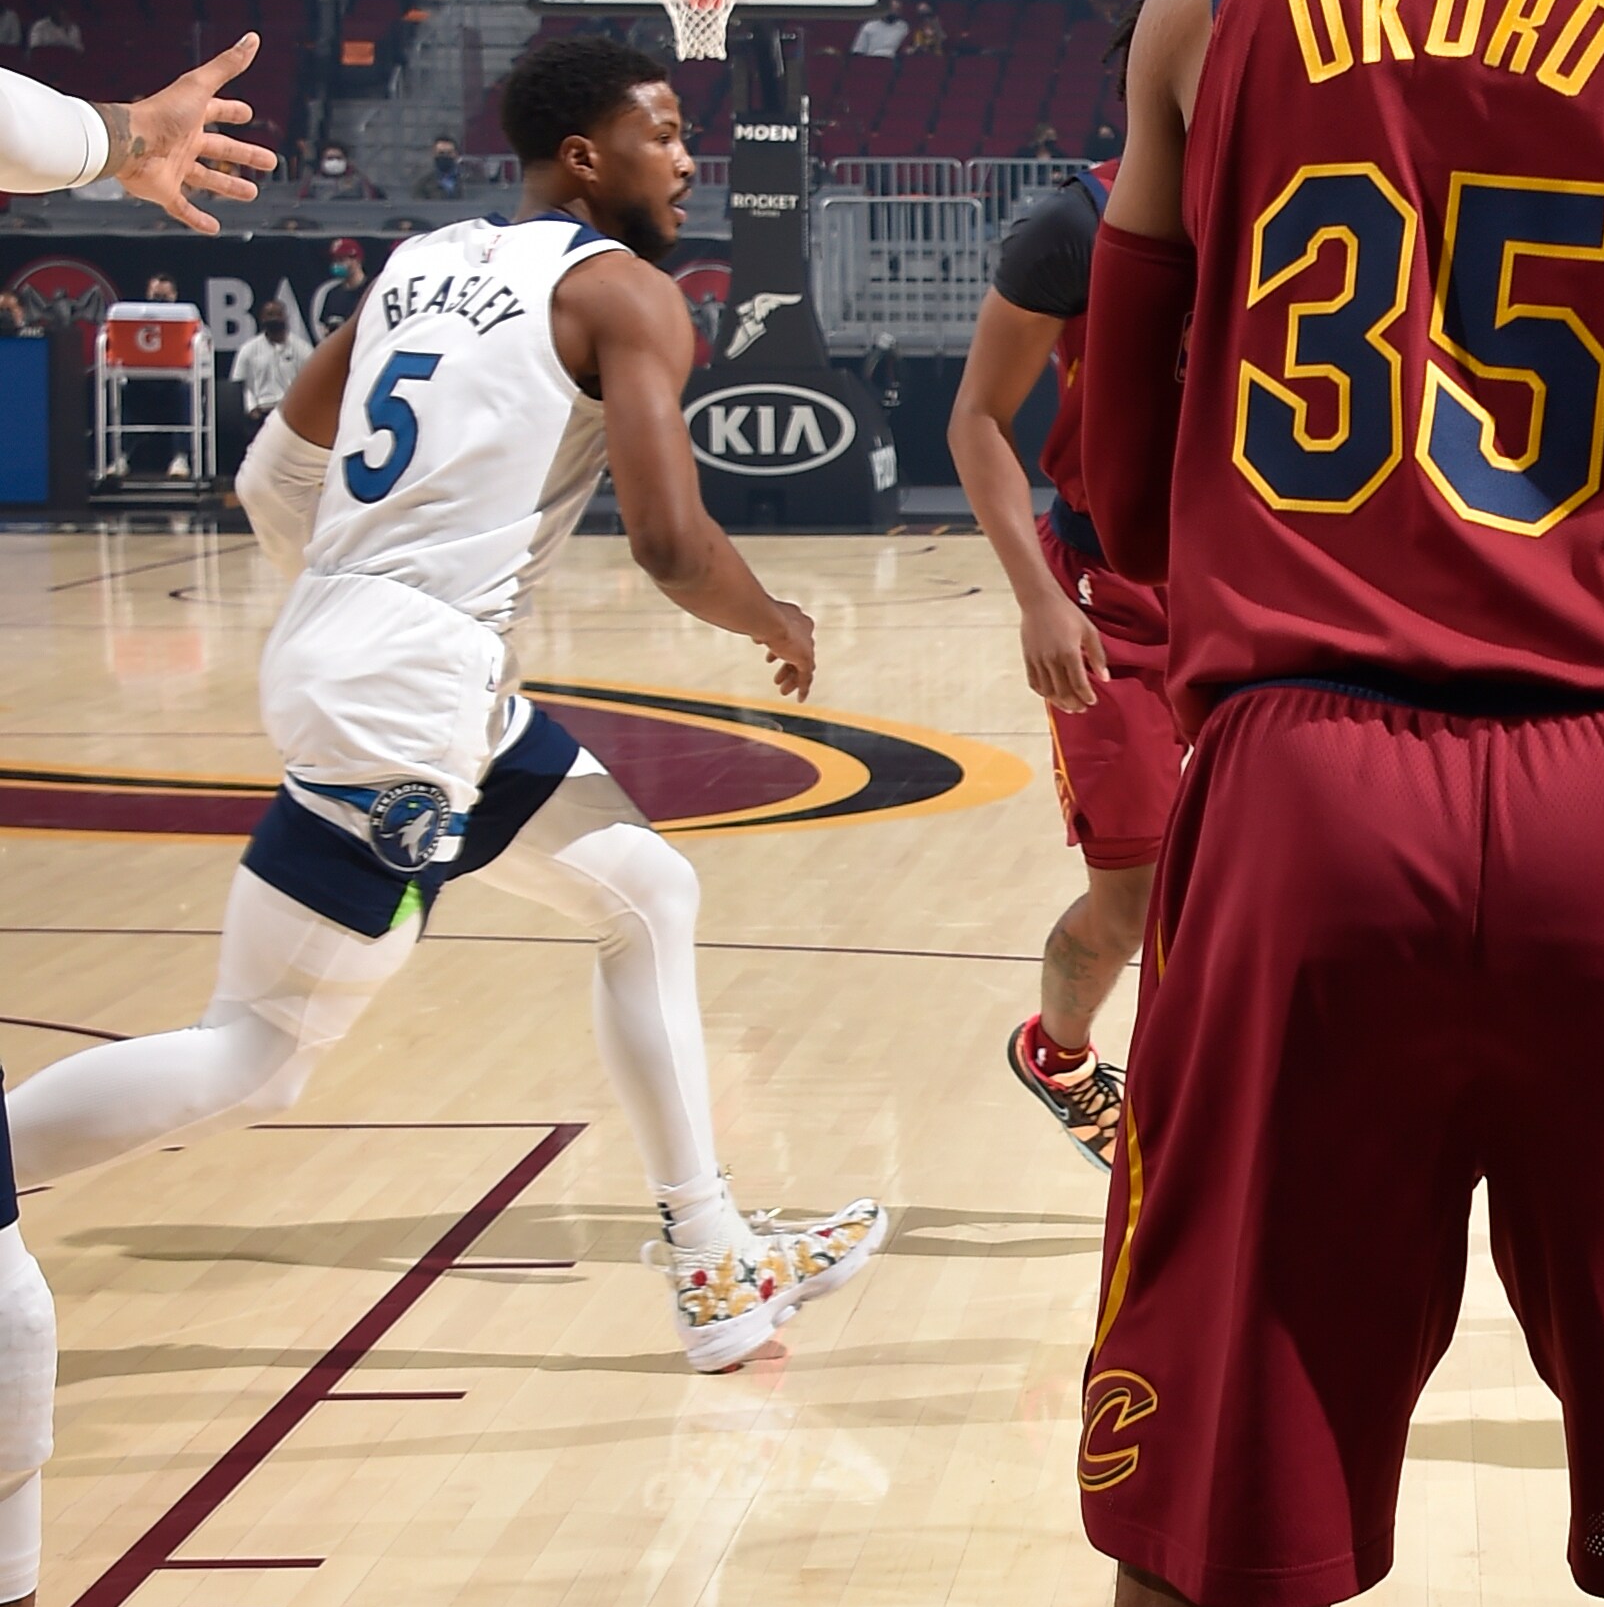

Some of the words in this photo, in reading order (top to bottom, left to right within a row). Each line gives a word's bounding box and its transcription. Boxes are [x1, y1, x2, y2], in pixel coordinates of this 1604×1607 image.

[734, 124, 798, 142] MOEN
[731, 192, 800, 210] ROCKET
[381, 275, 526, 337] BEASLEY
[341, 349, 445, 505] 5
[708, 404, 829, 456] KIA
